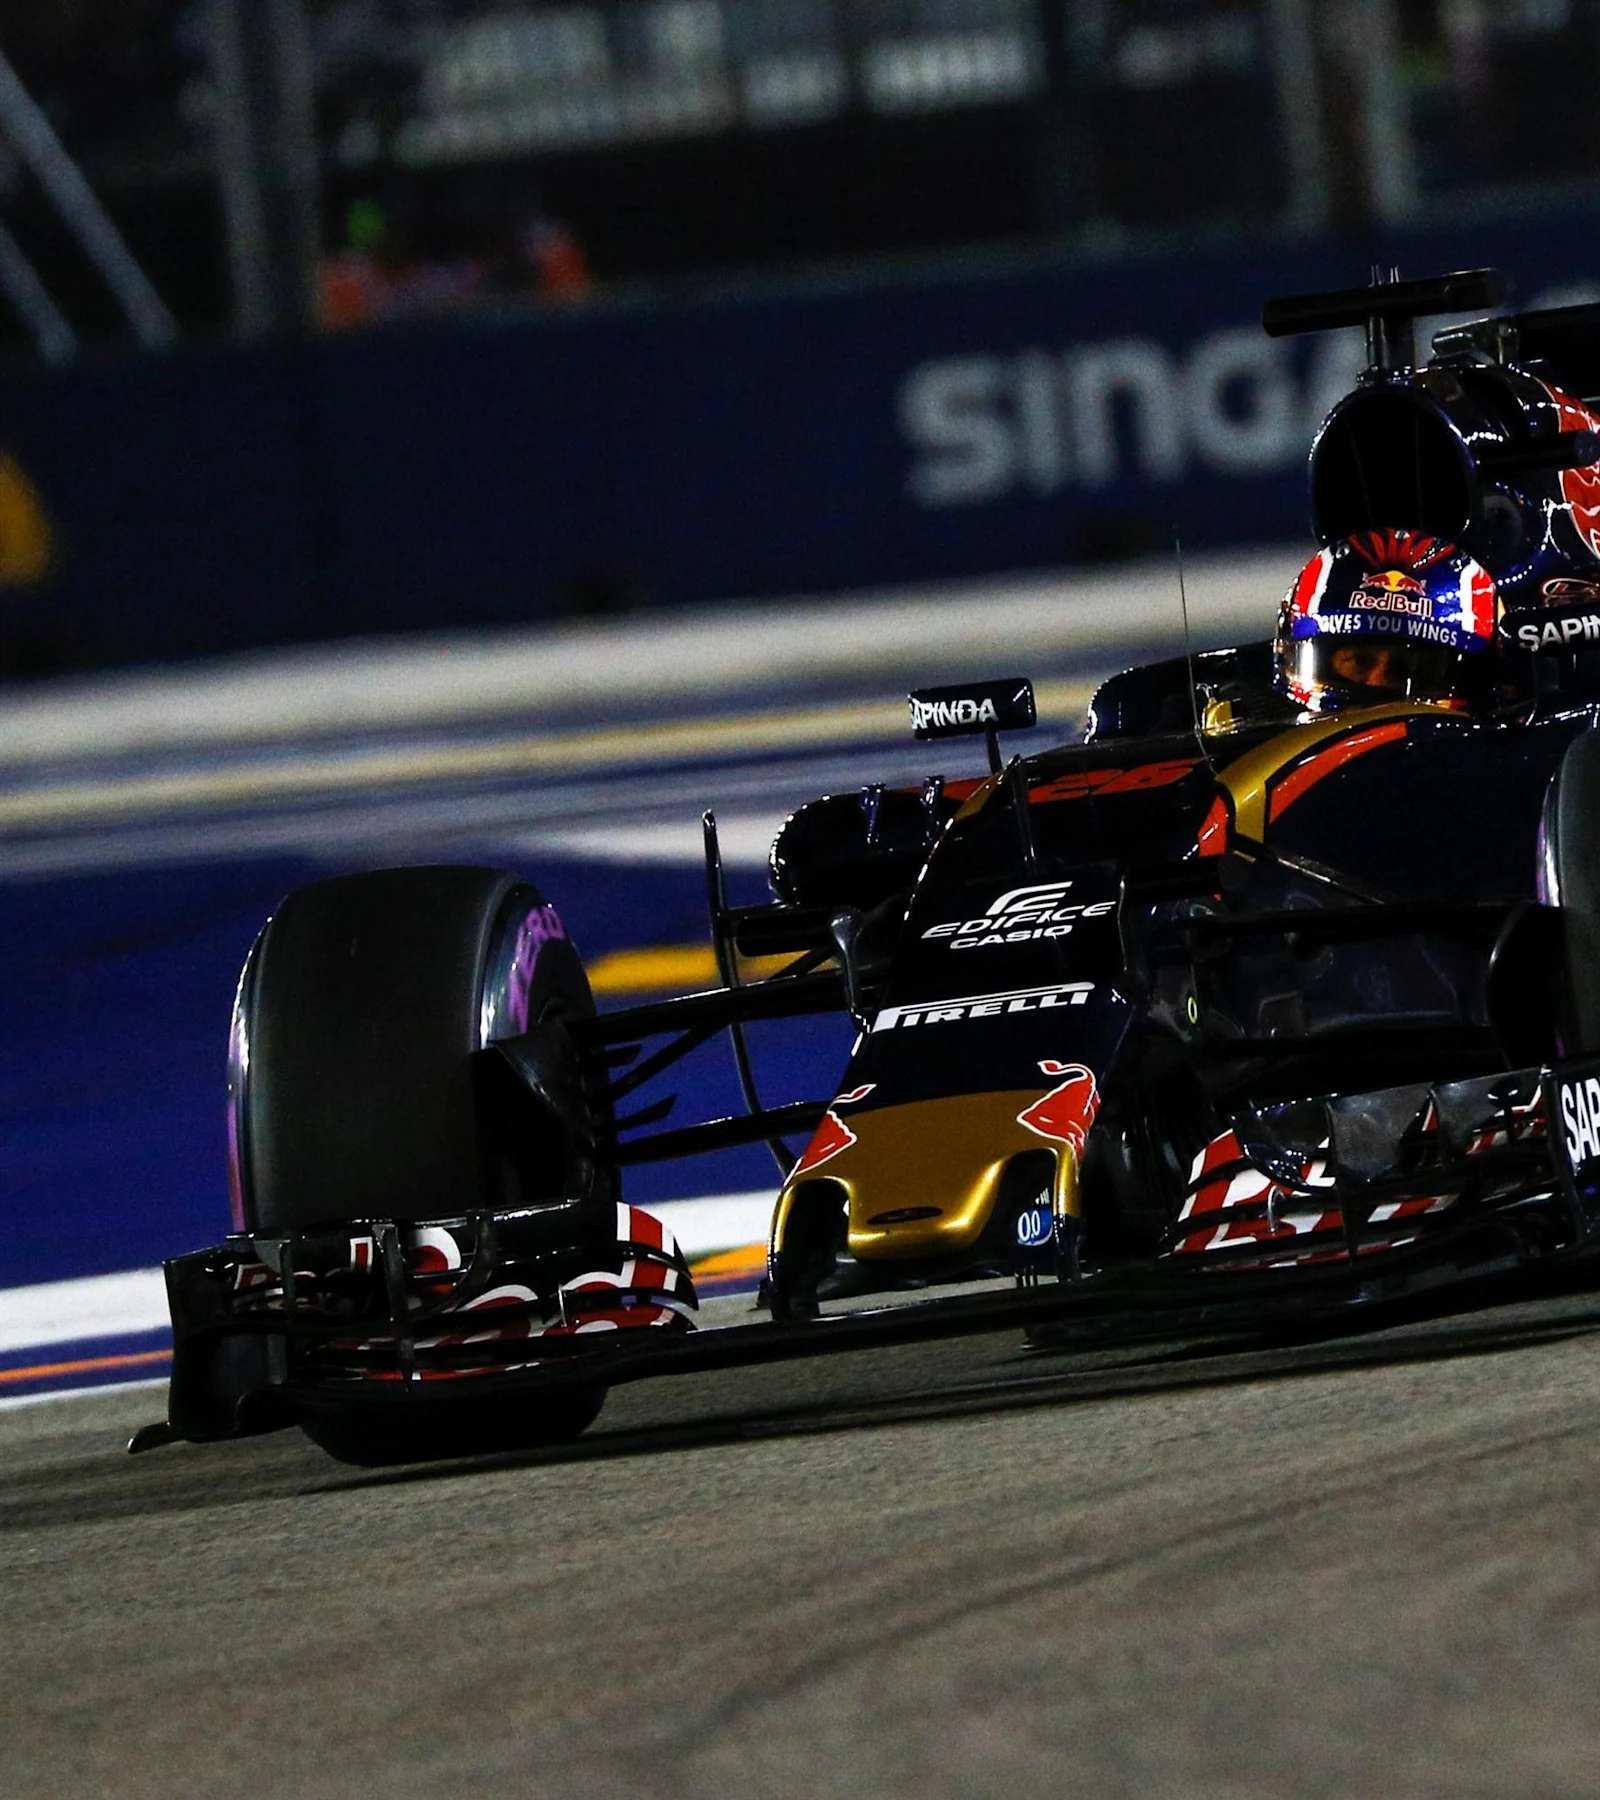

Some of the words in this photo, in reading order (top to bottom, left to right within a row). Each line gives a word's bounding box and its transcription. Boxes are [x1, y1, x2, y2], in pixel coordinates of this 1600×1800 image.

[1349, 591, 1391, 610] Red
[1394, 592, 1432, 617] Bull
[1320, 614, 1362, 633] GIVES
[1367, 616, 1400, 633] YOU
[1407, 619, 1458, 647] WINGS
[920, 901, 1117, 939] EDIFICE
[949, 924, 1073, 950] CASIO
[871, 981, 1095, 1034] PIRELLI
